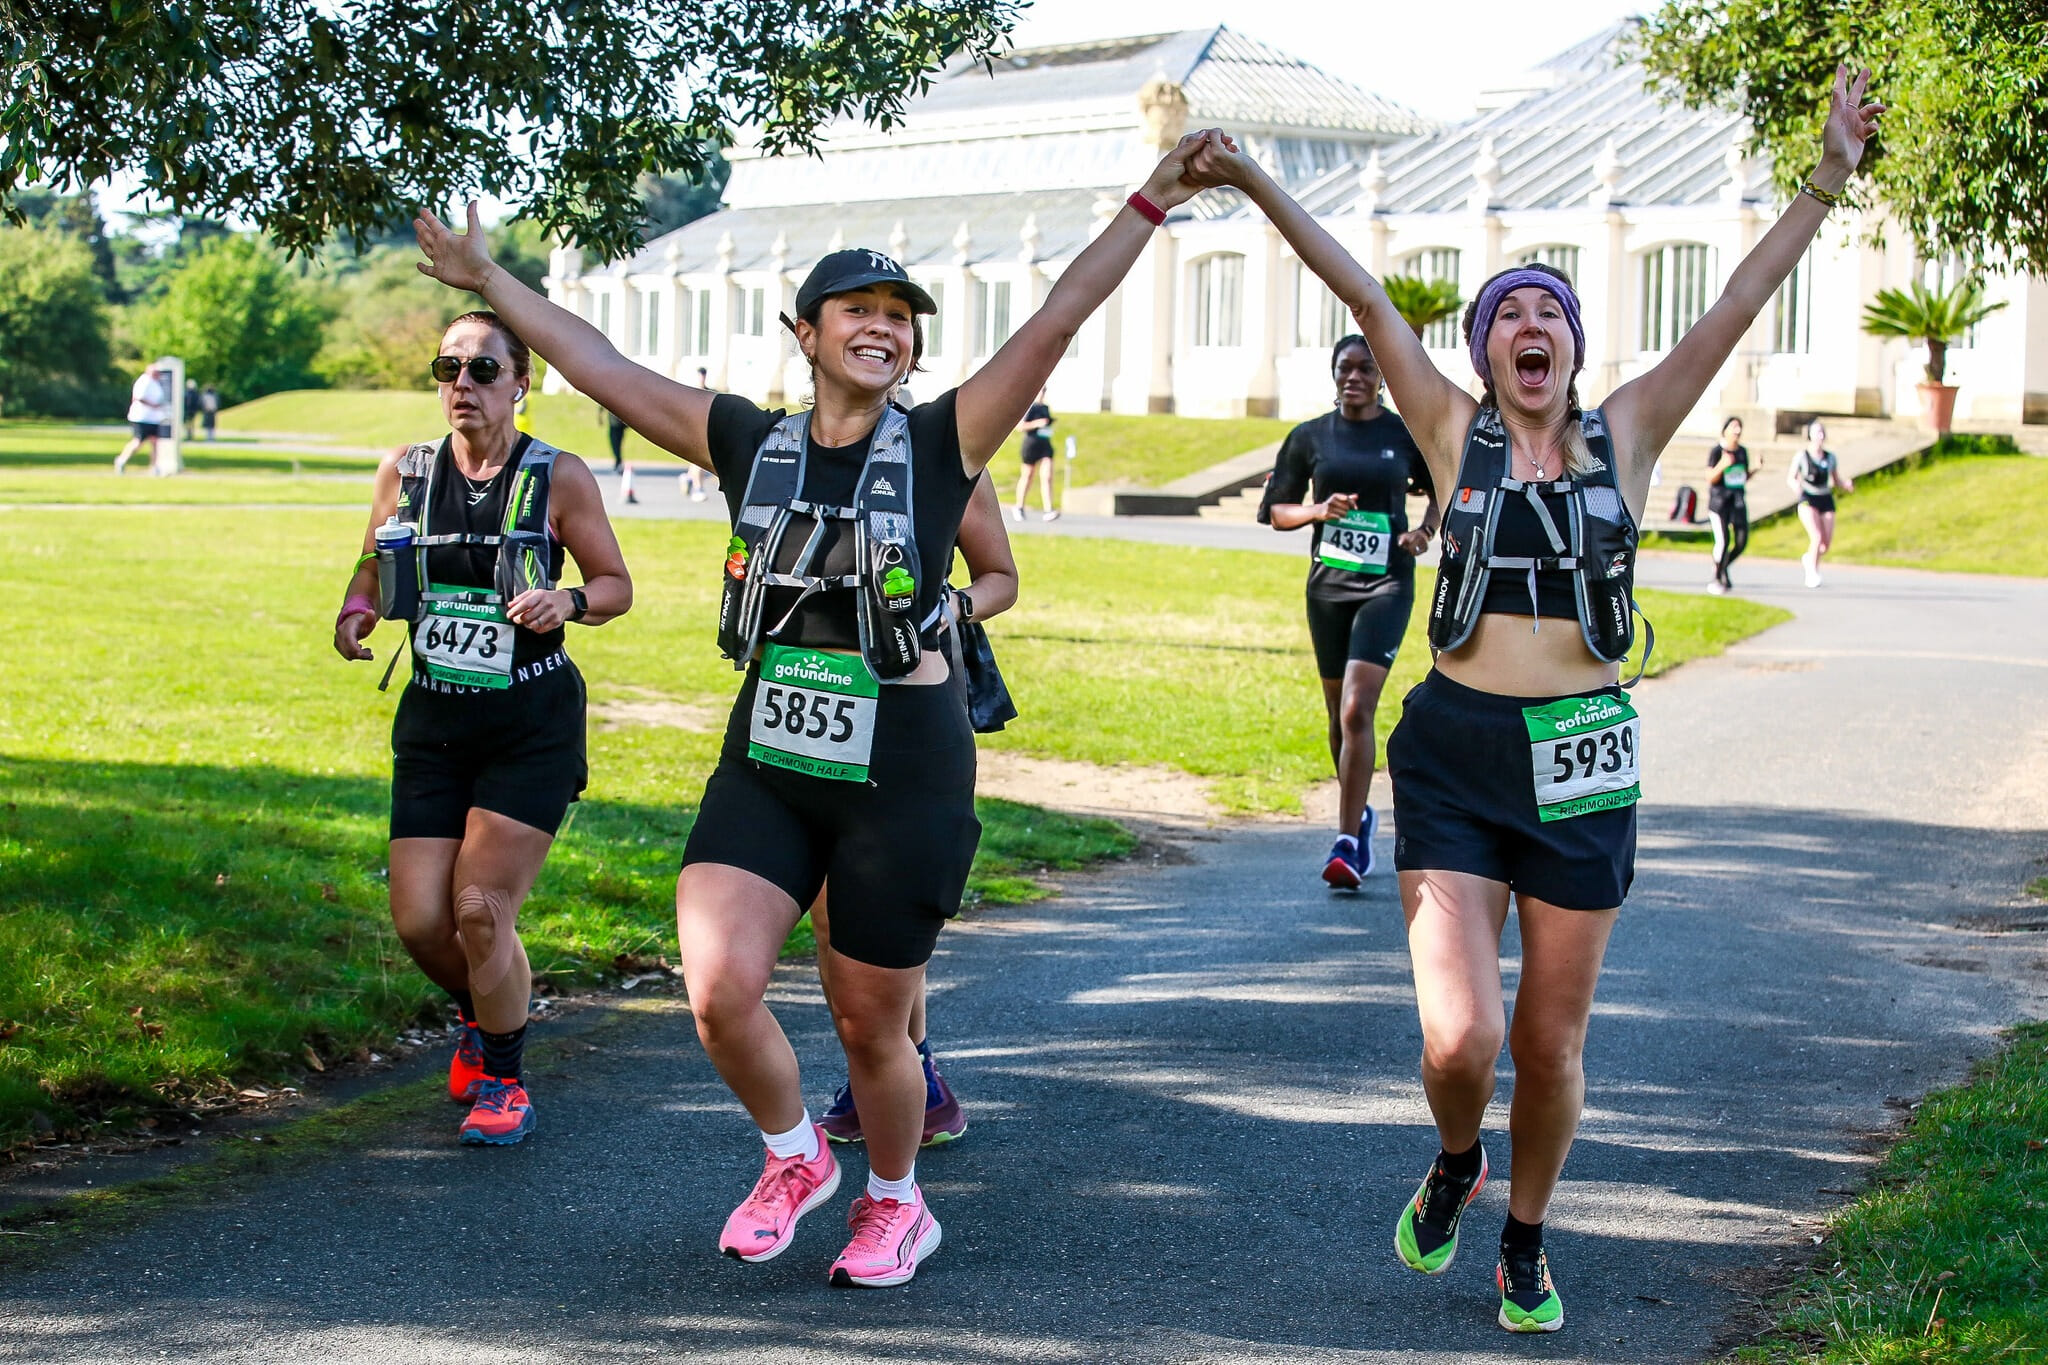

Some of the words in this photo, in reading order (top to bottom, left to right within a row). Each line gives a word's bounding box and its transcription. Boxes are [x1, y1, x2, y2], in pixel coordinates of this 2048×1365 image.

[1330, 529, 1380, 556] 4339
[720, 589, 732, 632] AONIJIE
[1434, 576, 1450, 619] AONIJIE
[1610, 596, 1625, 637] AONIJIE
[425, 618, 499, 659] 6473
[893, 626, 911, 664] AONIJIE
[466, 674, 494, 685] HALF
[774, 662, 853, 686] gofundme
[763, 686, 856, 743] 5855
[1555, 703, 1623, 732] gofundme
[762, 751, 815, 773] RICHMOND
[815, 765, 849, 778] HALF
[1553, 725, 1634, 784] 5939
[1559, 795, 1621, 816] RICHMOND
